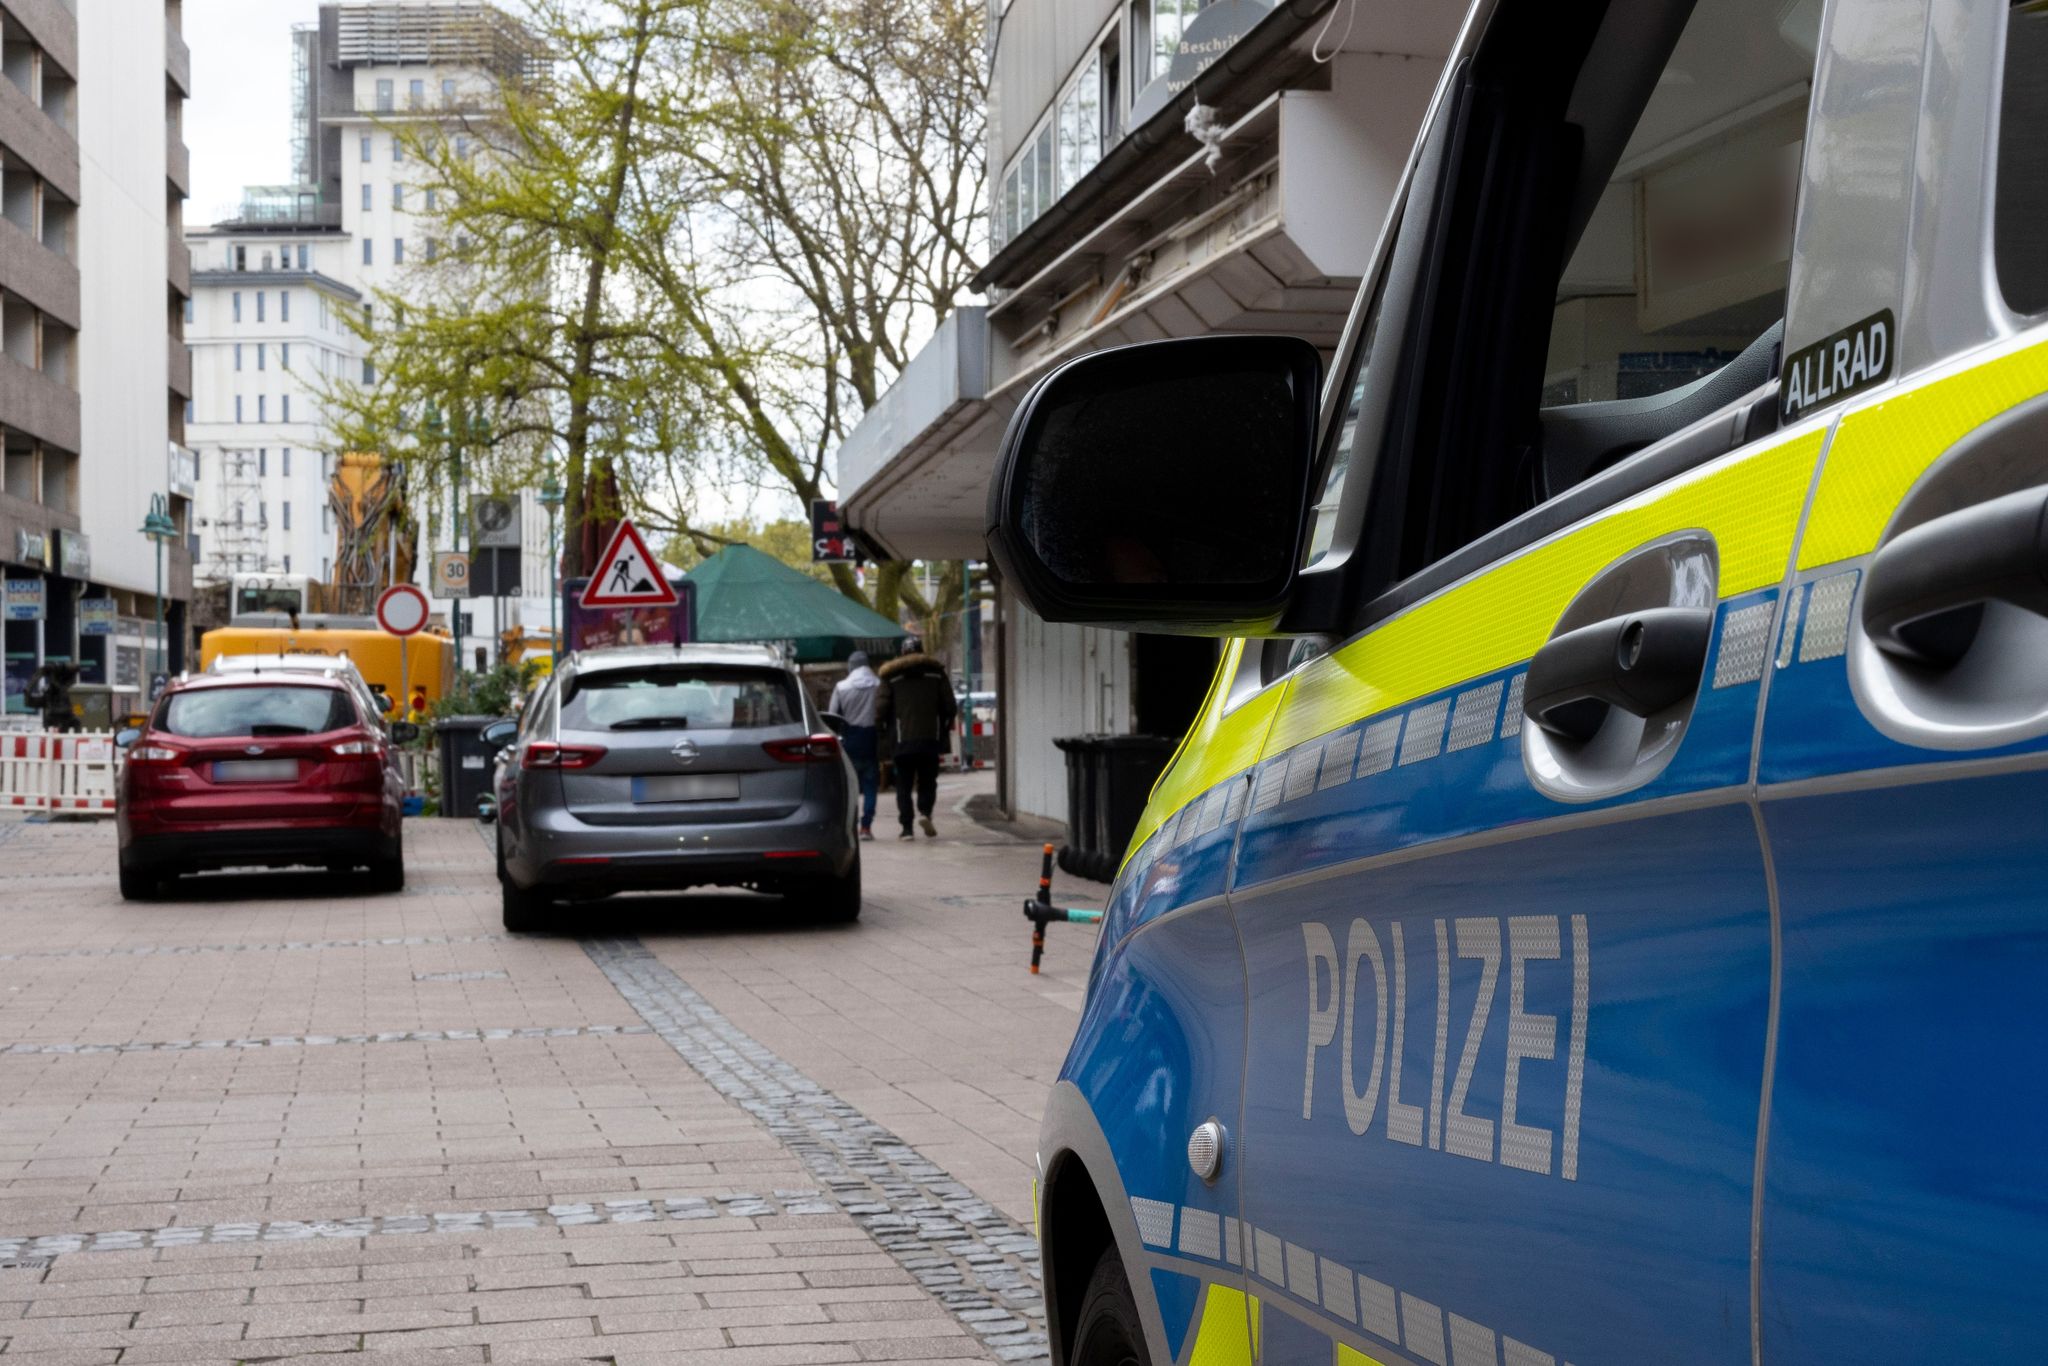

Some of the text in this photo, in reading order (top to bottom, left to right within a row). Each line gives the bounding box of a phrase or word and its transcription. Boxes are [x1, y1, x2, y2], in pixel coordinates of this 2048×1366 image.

[1785, 321, 1887, 415] ALLRAD
[447, 562, 465, 578] 30
[1301, 914, 1590, 1182] POLIZEI
